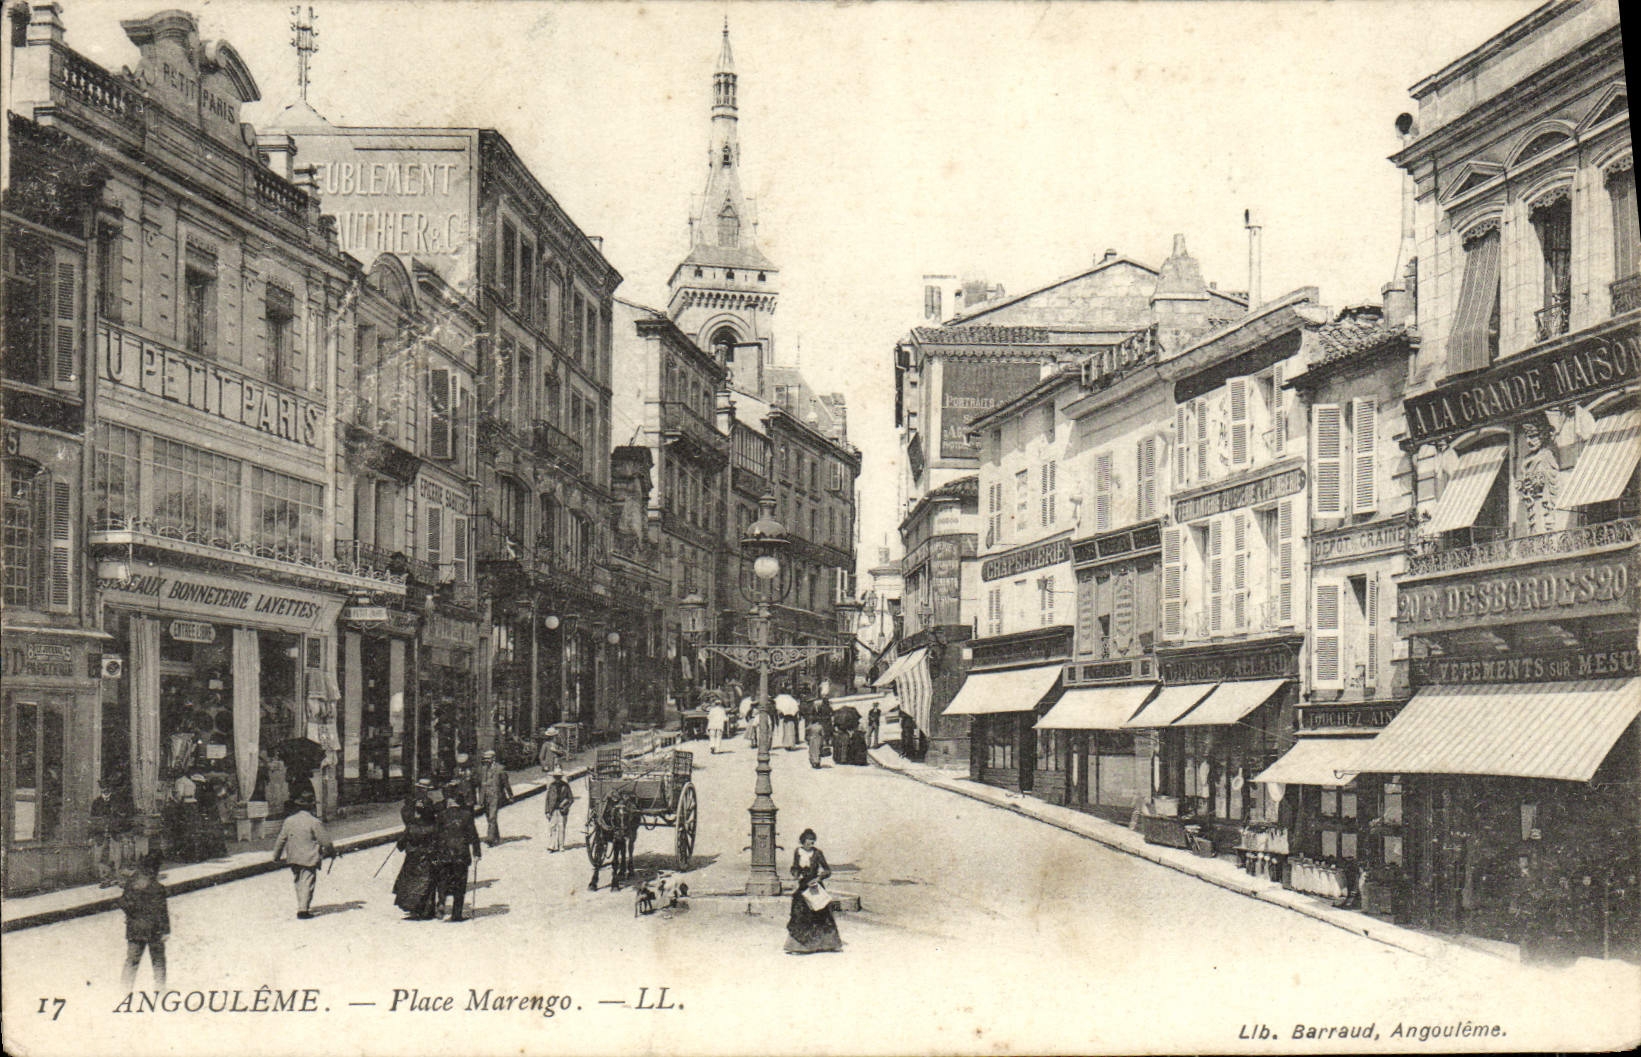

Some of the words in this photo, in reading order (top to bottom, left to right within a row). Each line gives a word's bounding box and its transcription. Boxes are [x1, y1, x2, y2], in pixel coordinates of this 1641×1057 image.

[163, 62, 197, 99] PETIT
[203, 89, 235, 124] PARIS
[138, 340, 225, 418] PETIT
[239, 377, 317, 447] PARIS
[1415, 405, 1427, 435] A
[1429, 397, 1457, 431] LA
[1459, 368, 1546, 423] GRANDE
[986, 540, 1066, 579] CHAPELLERIE
[168, 580, 253, 610] BONNETERIE
[1401, 591, 1421, 624] 20
[1446, 567, 1596, 618] DESBORDES
[1598, 562, 1629, 602] 20
[1549, 660, 1570, 677] SUR
